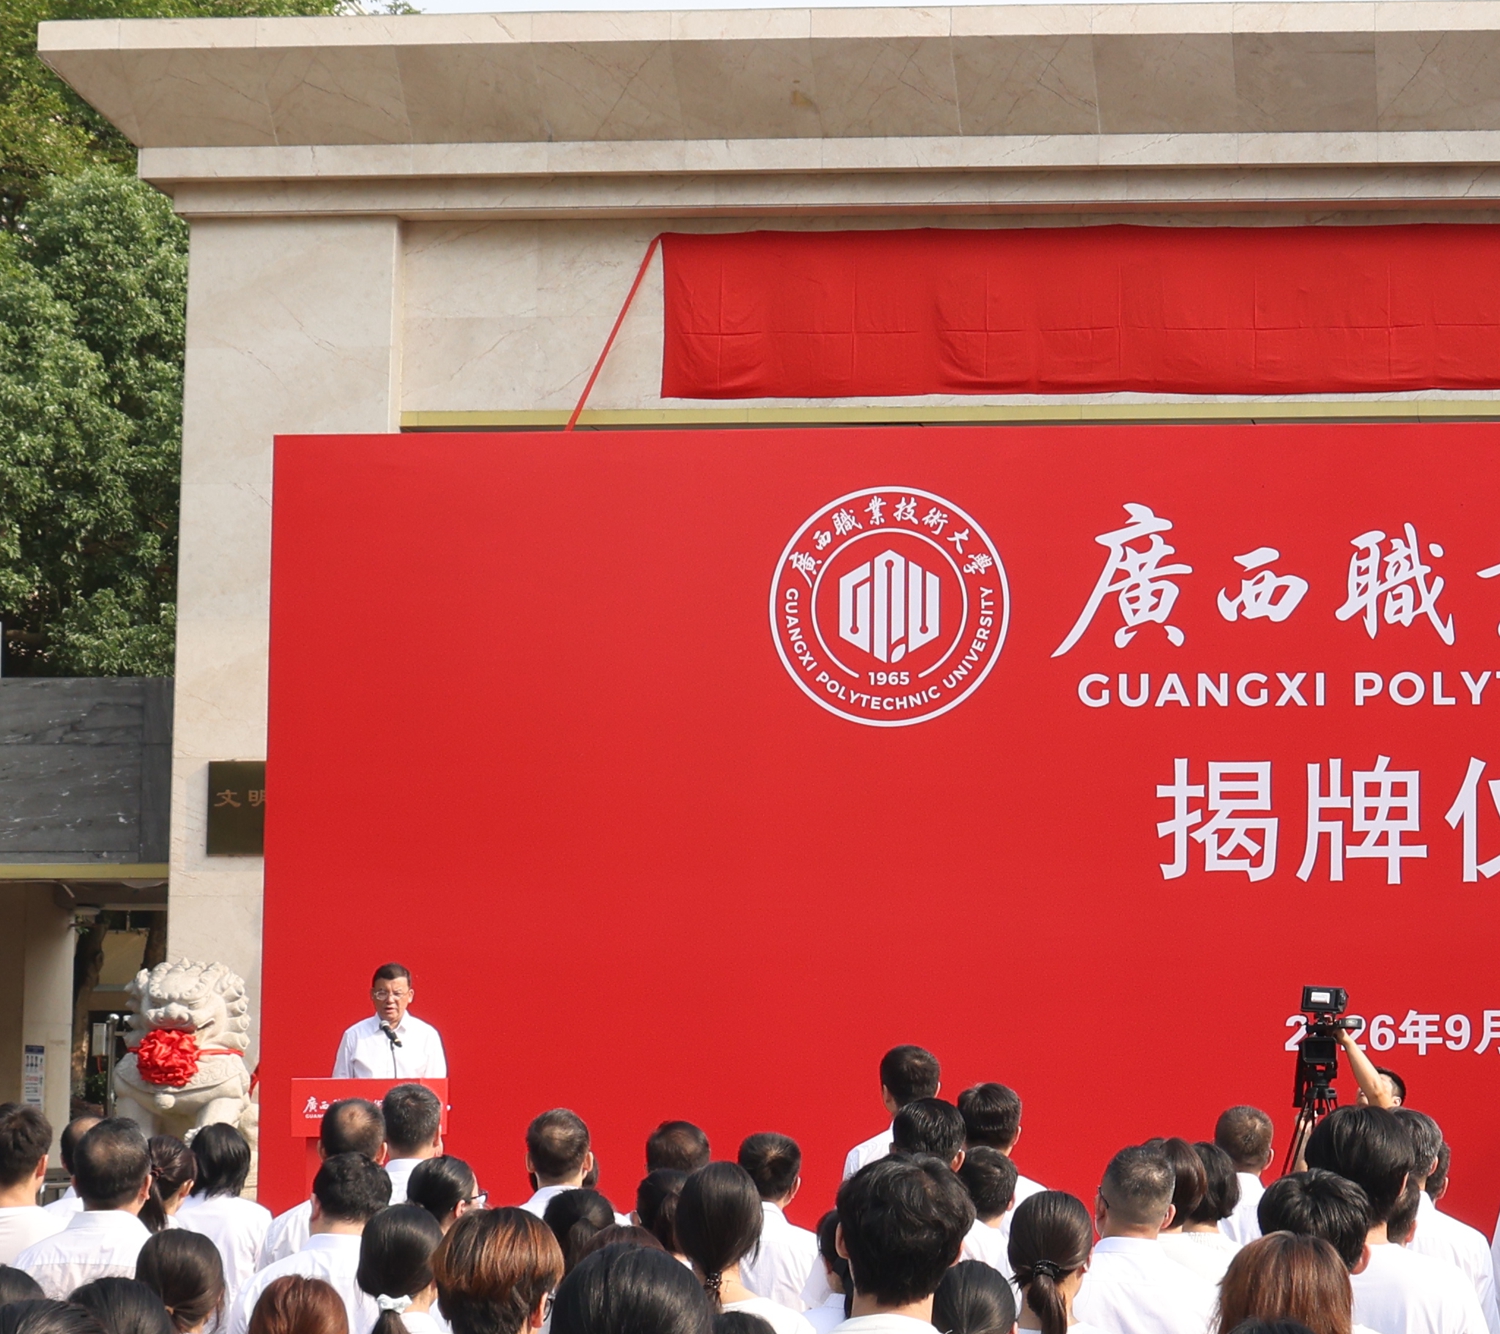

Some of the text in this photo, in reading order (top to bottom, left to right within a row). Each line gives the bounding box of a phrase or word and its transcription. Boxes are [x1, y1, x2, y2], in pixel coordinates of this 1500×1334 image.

[788, 495, 993, 588] 廣西職業技術大學
[784, 586, 994, 711] GUANGXI POLYTECHNIC UNIVERSITY
[868, 671, 910, 686] 1965
[1077, 672, 1325, 708] GUANGXI
